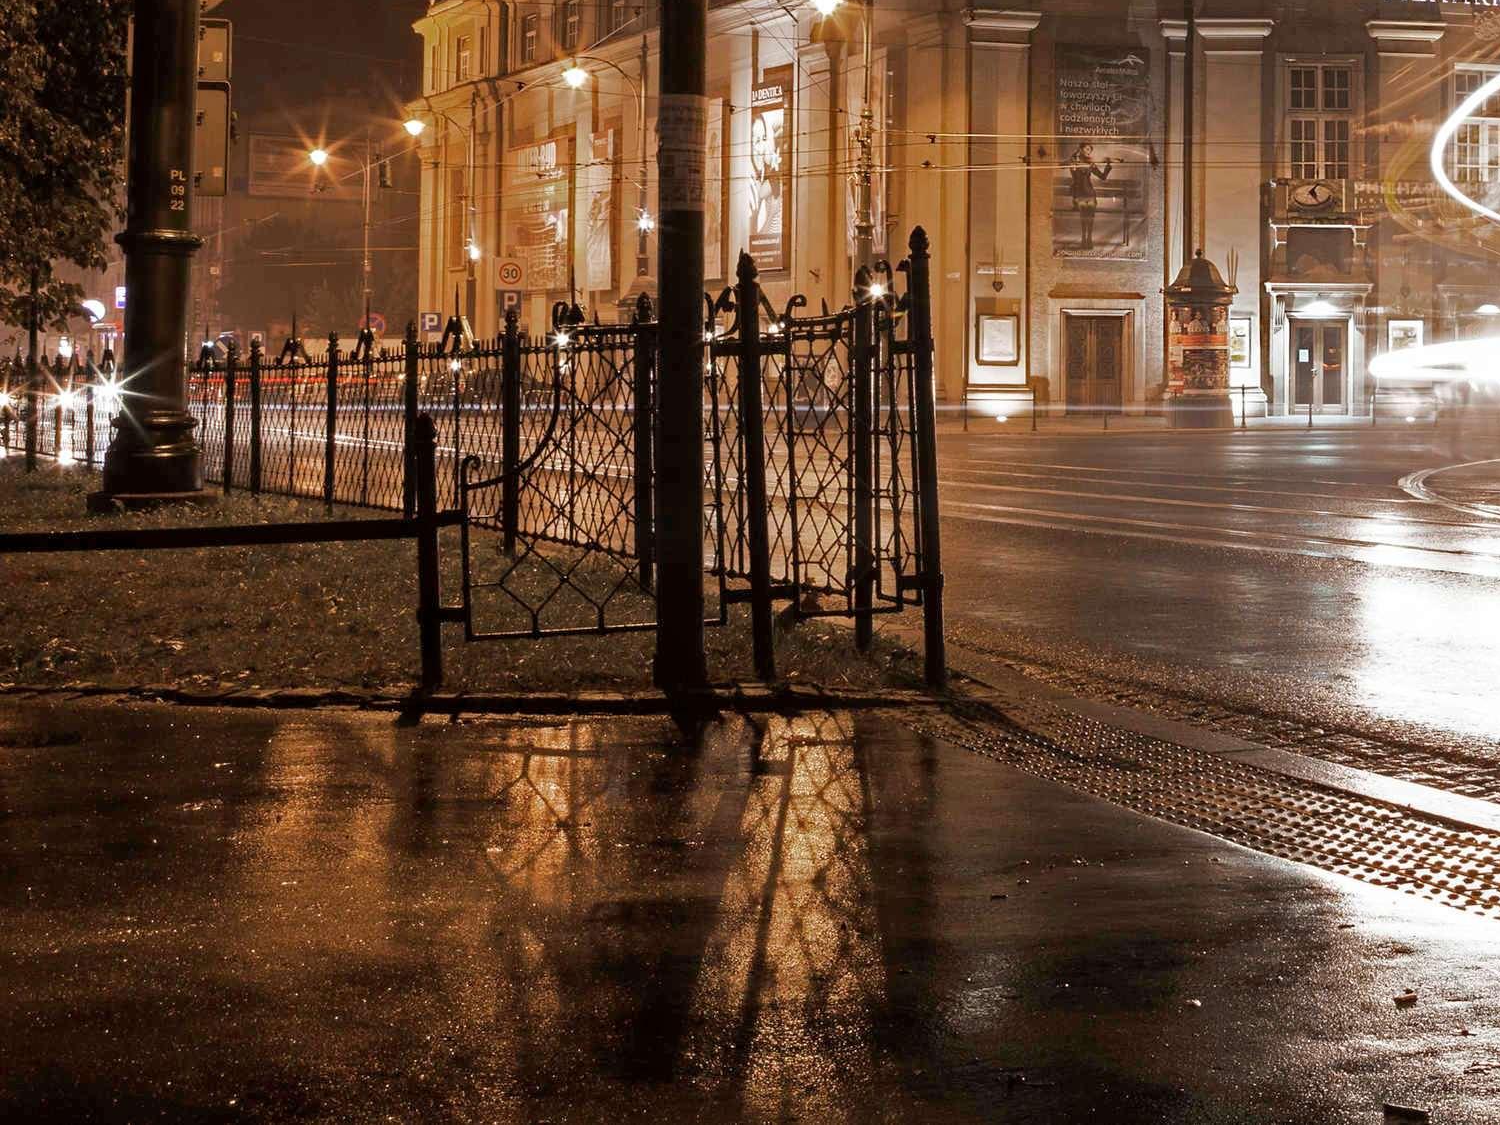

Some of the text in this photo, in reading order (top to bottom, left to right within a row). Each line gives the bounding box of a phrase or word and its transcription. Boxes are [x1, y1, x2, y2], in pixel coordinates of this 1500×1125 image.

[170, 170, 186, 181] PL
[170, 185, 185, 196] 09
[170, 199, 185, 211] 22
[503, 267, 518, 279] 30
[504, 292, 518, 310] P
[425, 314, 439, 331] P
